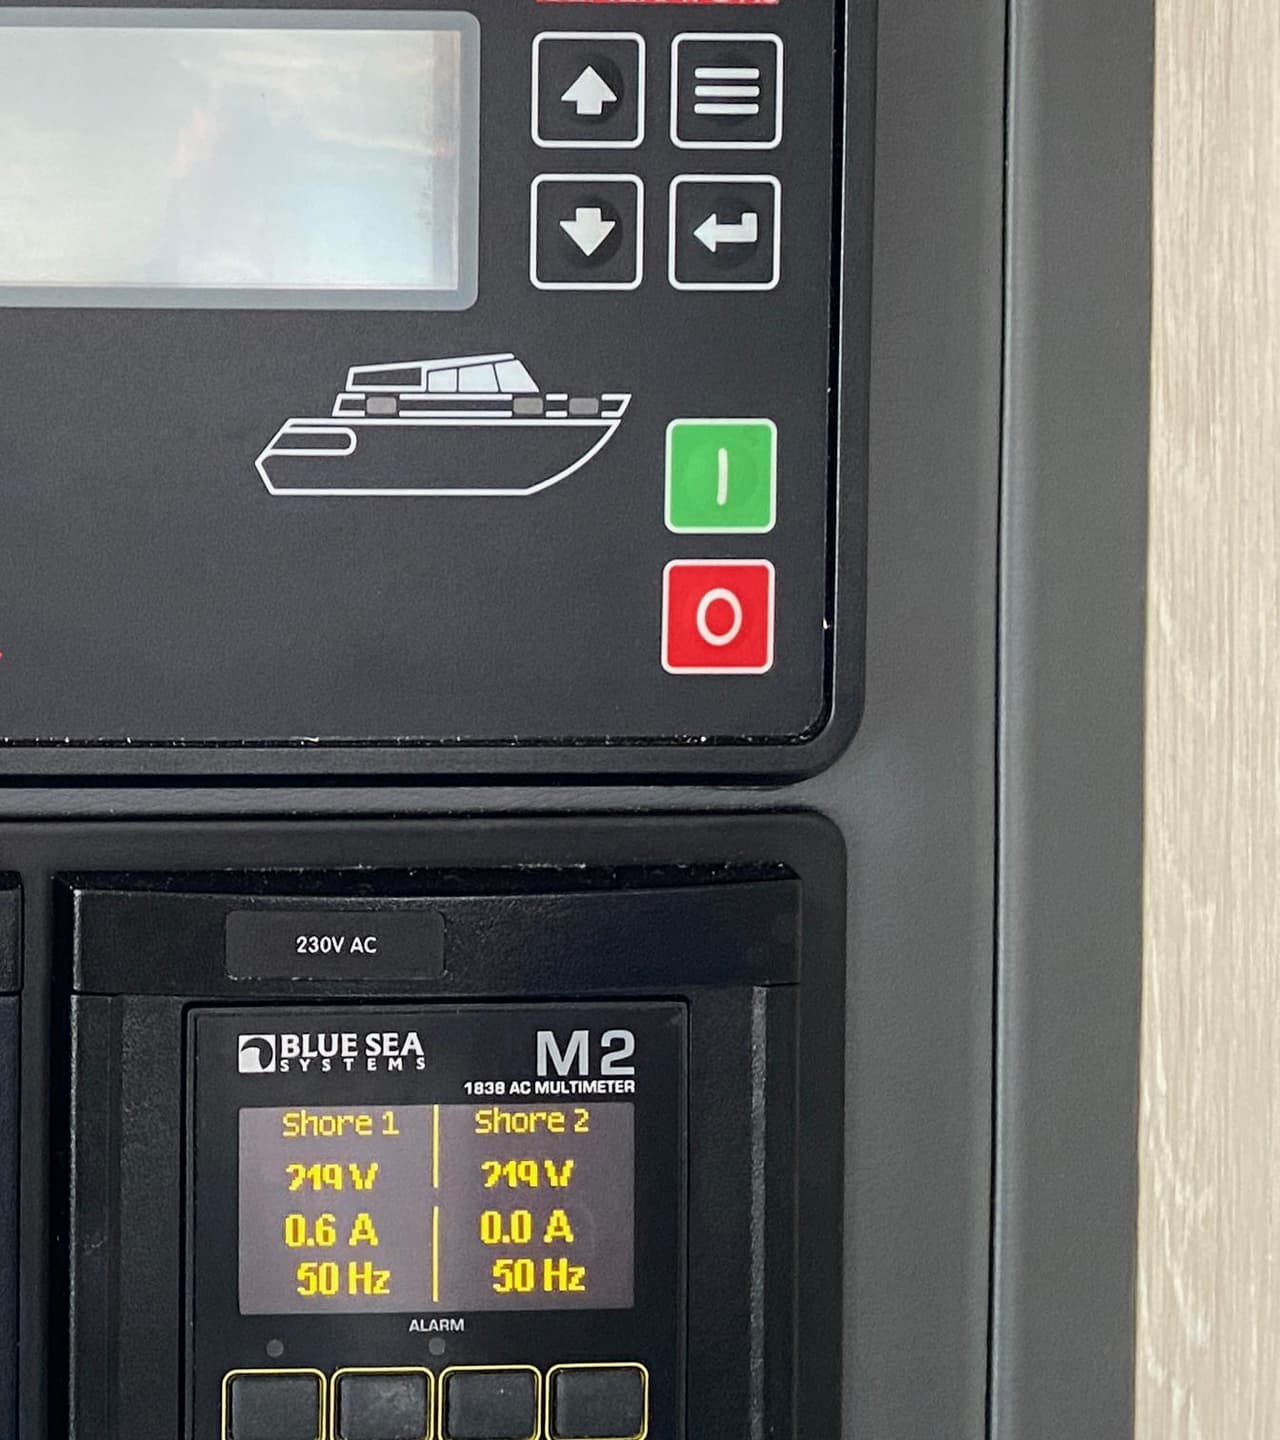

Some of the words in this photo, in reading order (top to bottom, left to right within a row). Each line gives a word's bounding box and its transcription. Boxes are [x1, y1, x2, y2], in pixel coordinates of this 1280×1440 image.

[463, 1081, 506, 1095] 1838
[509, 1080, 532, 1095] AC
[534, 1079, 636, 1094] MULTIMETER
[282, 1111, 372, 1138] Shore
[381, 1111, 399, 1136] 1
[284, 1214, 336, 1248] 0.6
[349, 1214, 378, 1245] A
[296, 1262, 338, 1296] 50
[348, 1261, 390, 1296] Hz
